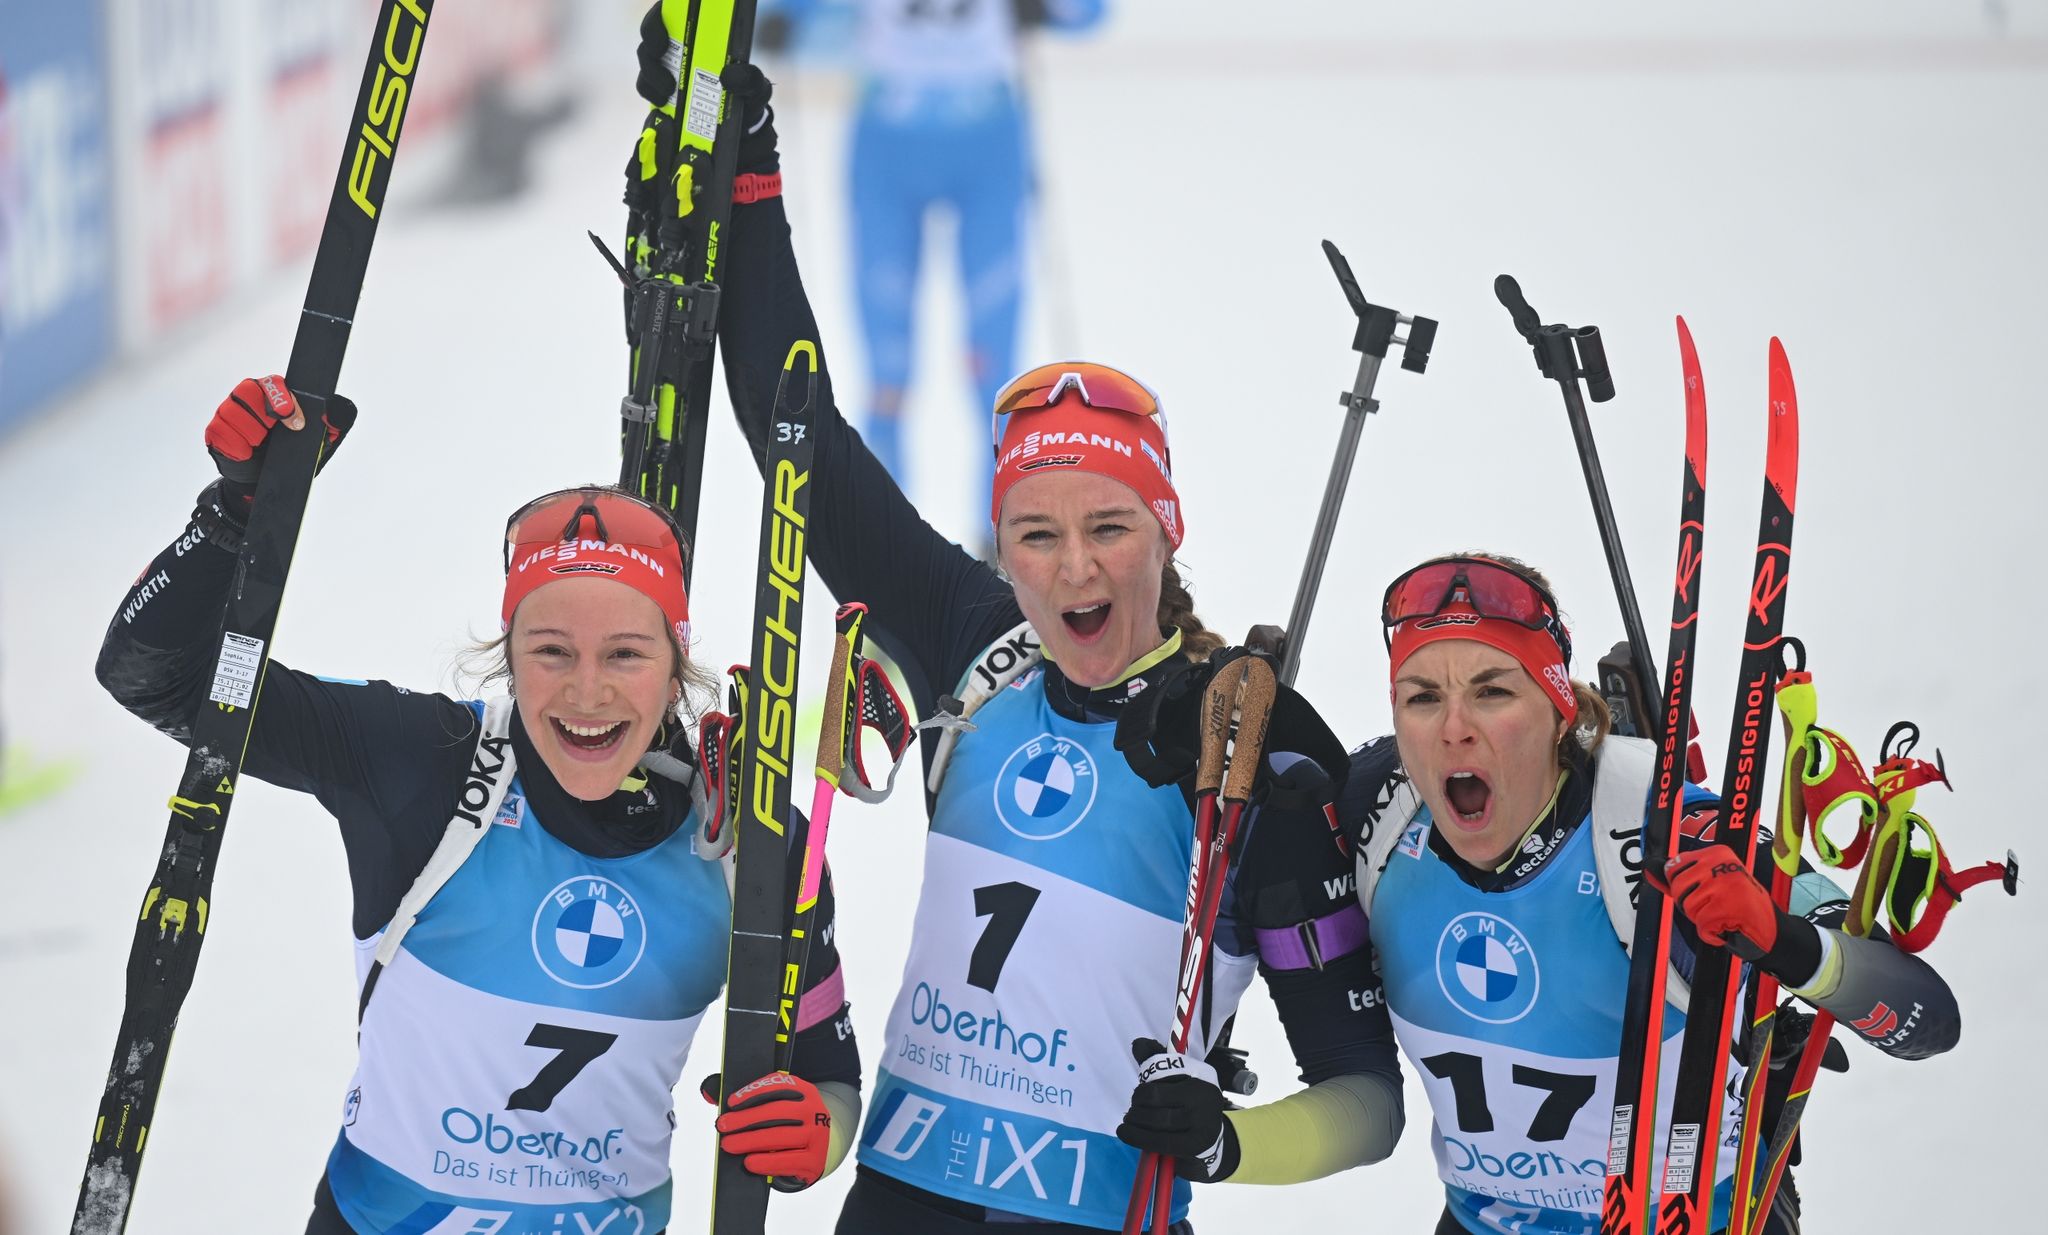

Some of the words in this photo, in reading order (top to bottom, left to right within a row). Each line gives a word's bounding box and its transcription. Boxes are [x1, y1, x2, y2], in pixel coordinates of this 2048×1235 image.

[776, 422, 807, 445] 37
[1152, 500, 1180, 545] adidas
[123, 569, 171, 624] WÜRTH
[753, 459, 809, 838] FISCHER
[1543, 666, 1574, 707] adidas
[1026, 742, 1091, 777] BMW
[1657, 649, 1686, 809] ROSSIGNOL
[1729, 671, 1767, 830] ROSSIGNOL
[453, 734, 512, 829] JOKA
[1514, 827, 1565, 878] tectake
[554, 881, 635, 919] BMW
[966, 880, 1042, 994] 1
[1451, 918, 1525, 955] BMW
[911, 981, 1075, 1072] Oberhof.
[504, 1022, 619, 1113] 7
[899, 1033, 925, 1065] Das
[930, 1045, 952, 1075] ist
[959, 1053, 1073, 1107] Thüringen
[1420, 1051, 1597, 1142] 17
[442, 1107, 624, 1164] Oberhof.
[945, 1129, 971, 1181] THE
[973, 1116, 1088, 1207] iX1
[433, 1150, 479, 1179] Das
[488, 1162, 519, 1187] ist
